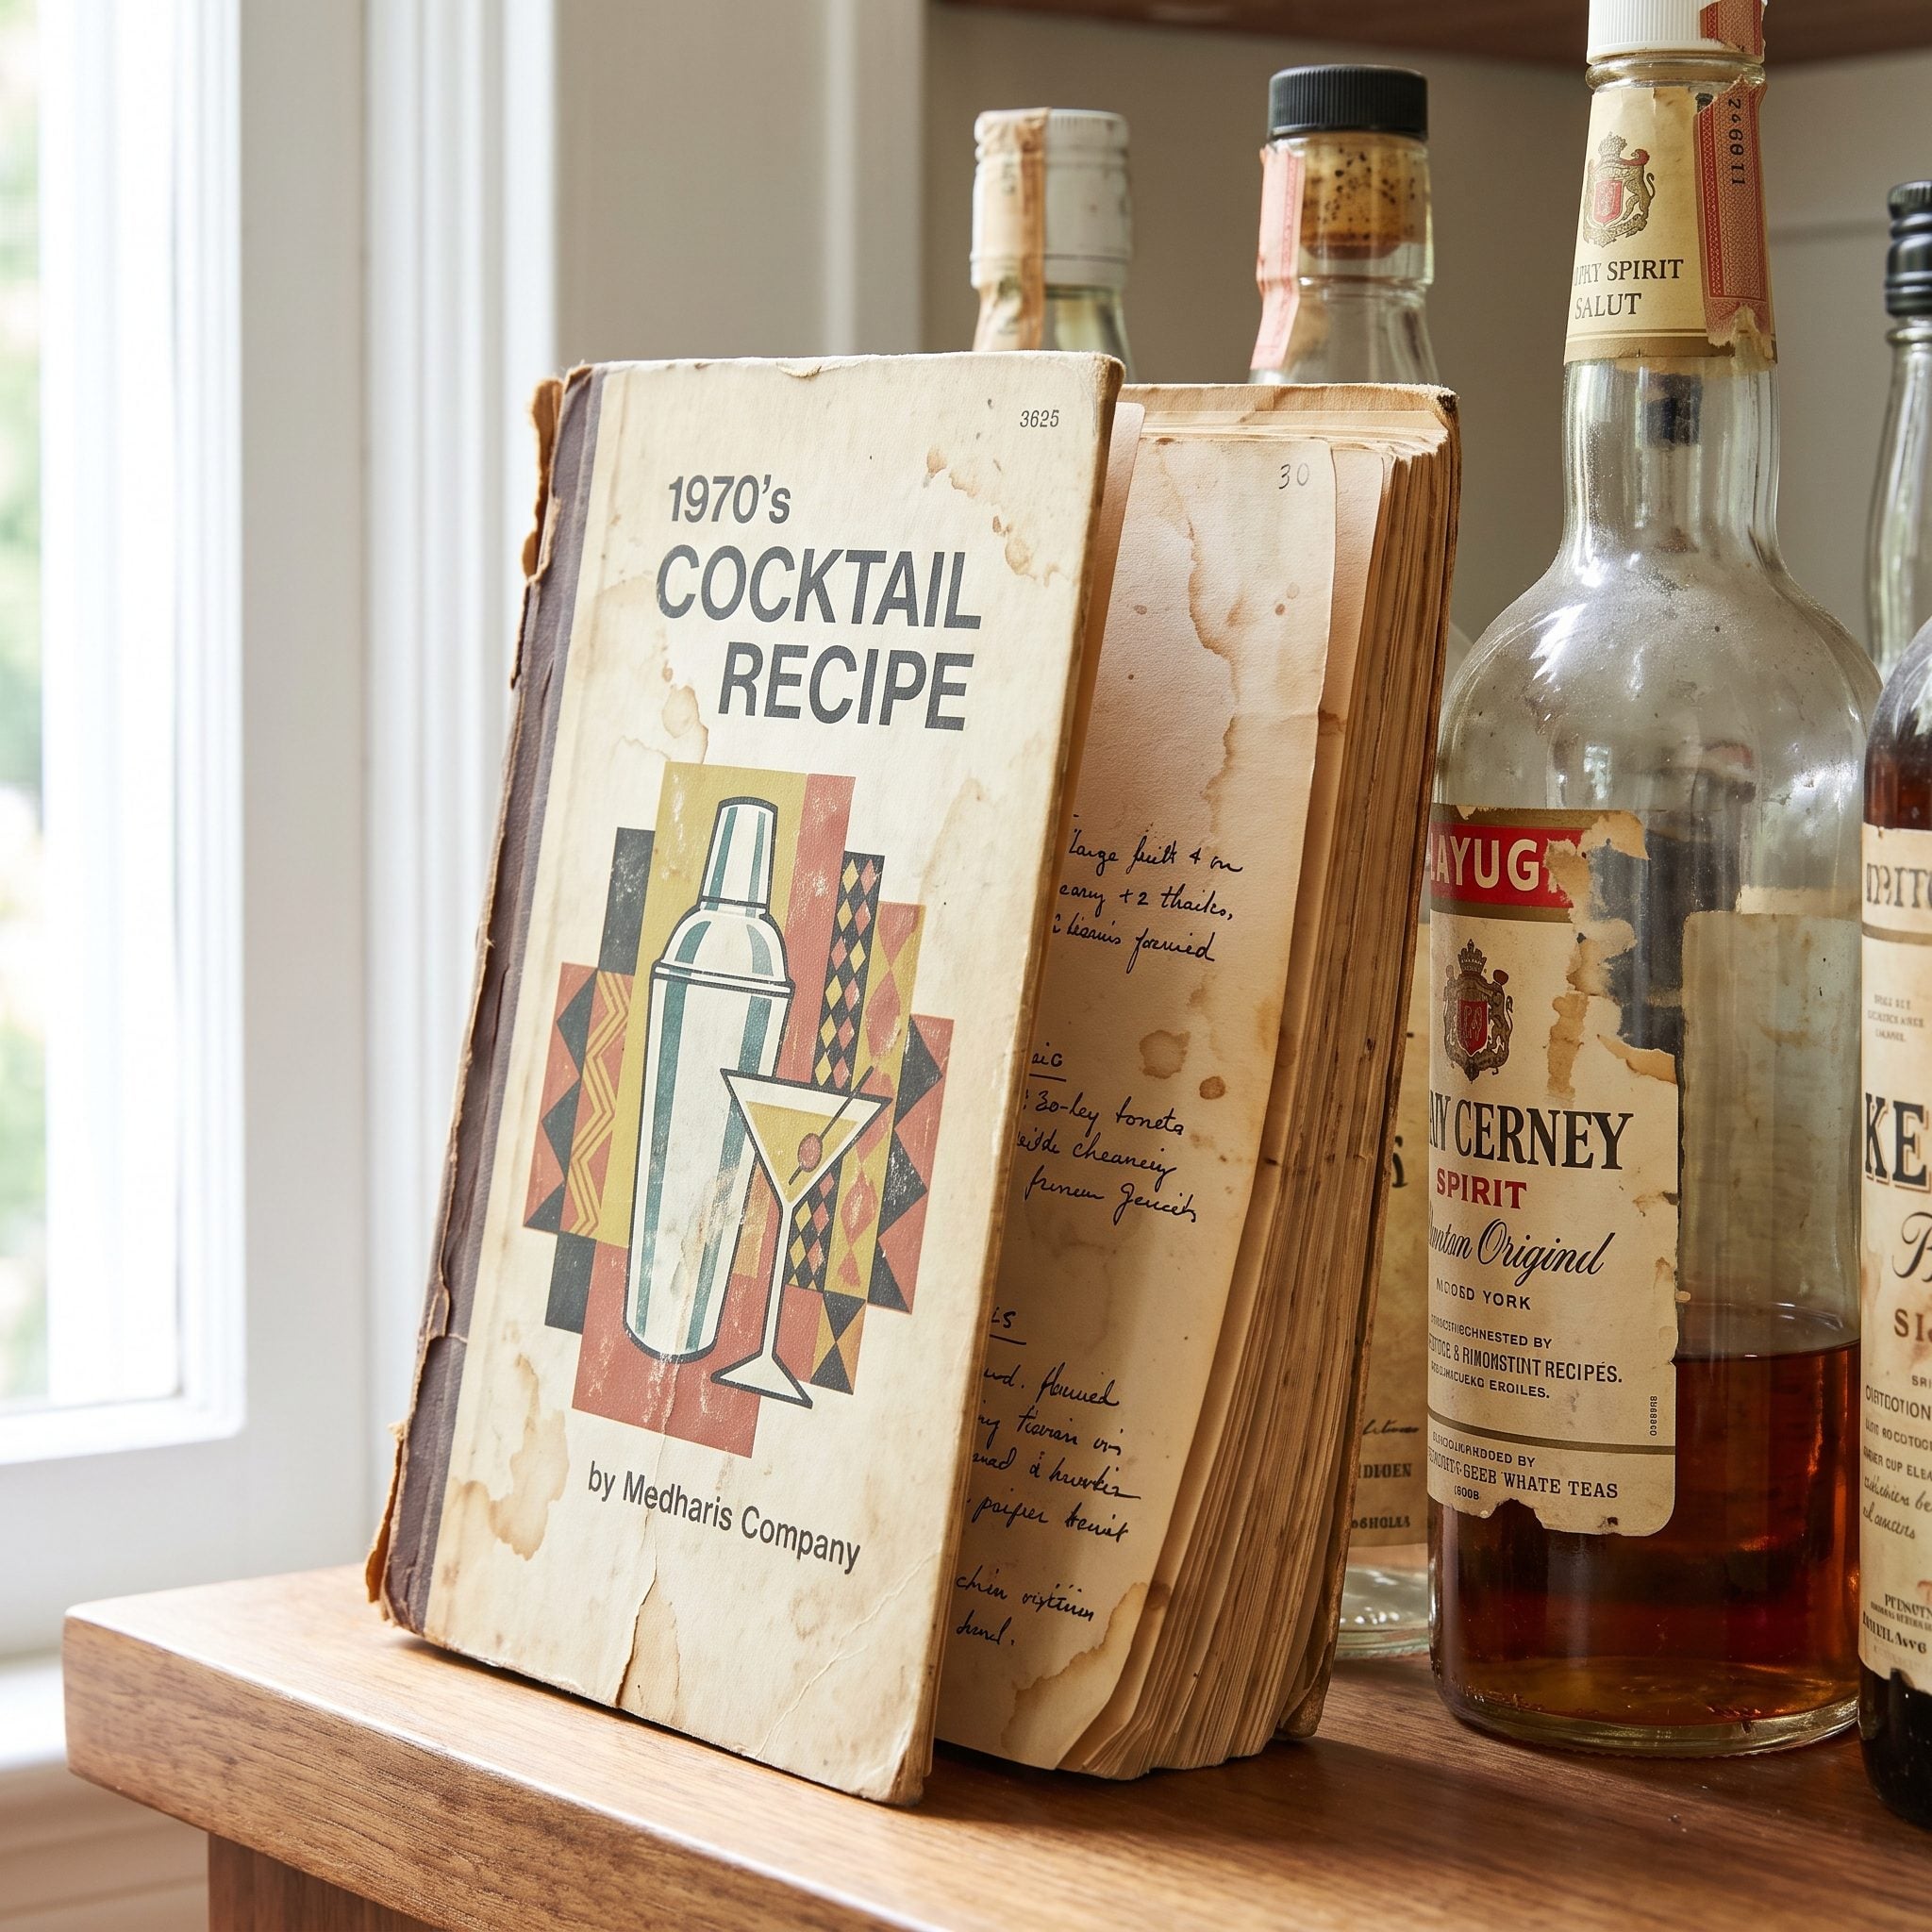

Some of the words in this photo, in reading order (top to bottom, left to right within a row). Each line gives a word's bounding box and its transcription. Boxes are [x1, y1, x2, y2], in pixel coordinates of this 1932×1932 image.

[1607, 258, 1684, 281] SPIRIT
[1575, 292, 1641, 320] SALUT
[1020, 409, 1059, 428] 3625
[668, 475, 791, 524] 1970's
[657, 544, 982, 630] COCKTAIL
[718, 641, 974, 731] RECIPE
[1455, 1099, 1634, 1170] CERNEY
[1437, 1167, 1527, 1209] SPIRIT
[1483, 1291, 1531, 1310] YORK
[1533, 1337, 1553, 1349] BY
[1490, 1379, 1550, 1399] EROILES.
[1518, 1455, 1536, 1468] BY
[1503, 1472, 1561, 1494] WHATE
[1568, 1480, 1619, 1498] TEAS
[589, 1460, 616, 1502] by
[623, 1471, 733, 1531] Medharis
[741, 1506, 860, 1574] Company
